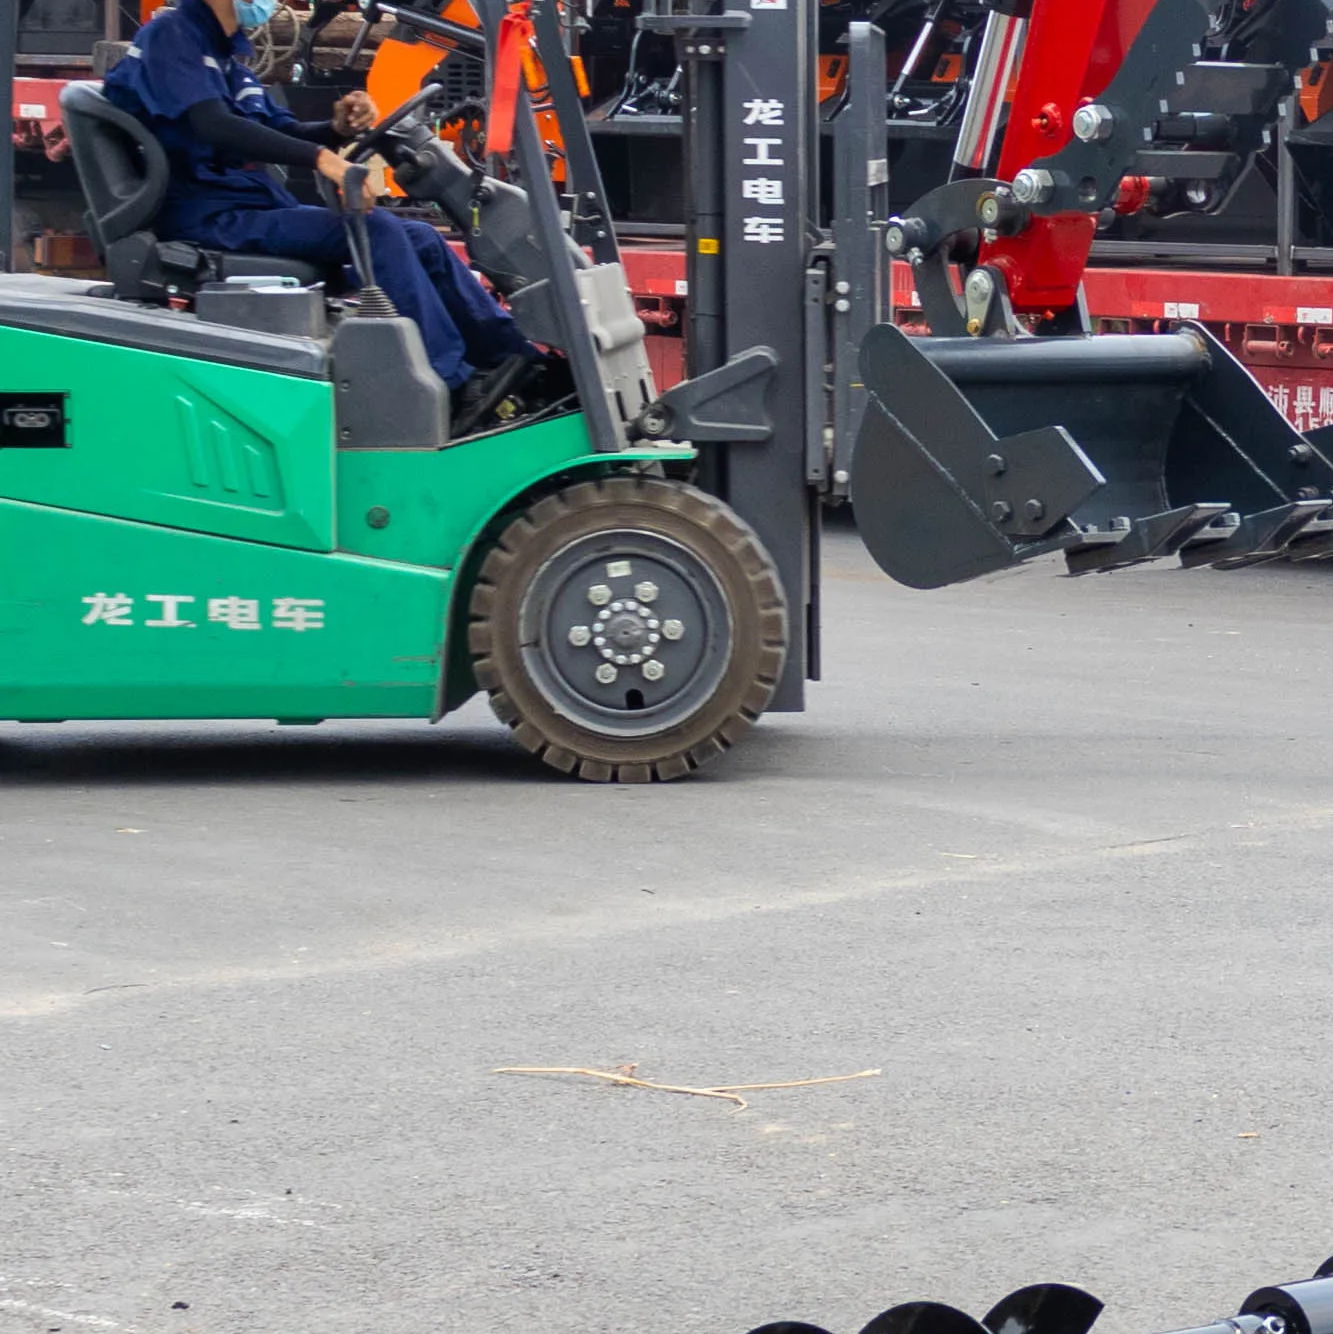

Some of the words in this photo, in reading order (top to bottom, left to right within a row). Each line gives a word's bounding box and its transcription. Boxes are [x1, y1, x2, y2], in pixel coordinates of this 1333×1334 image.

[743, 99, 784, 243] 龙工电车
[82, 592, 325, 632] 龙工电车
